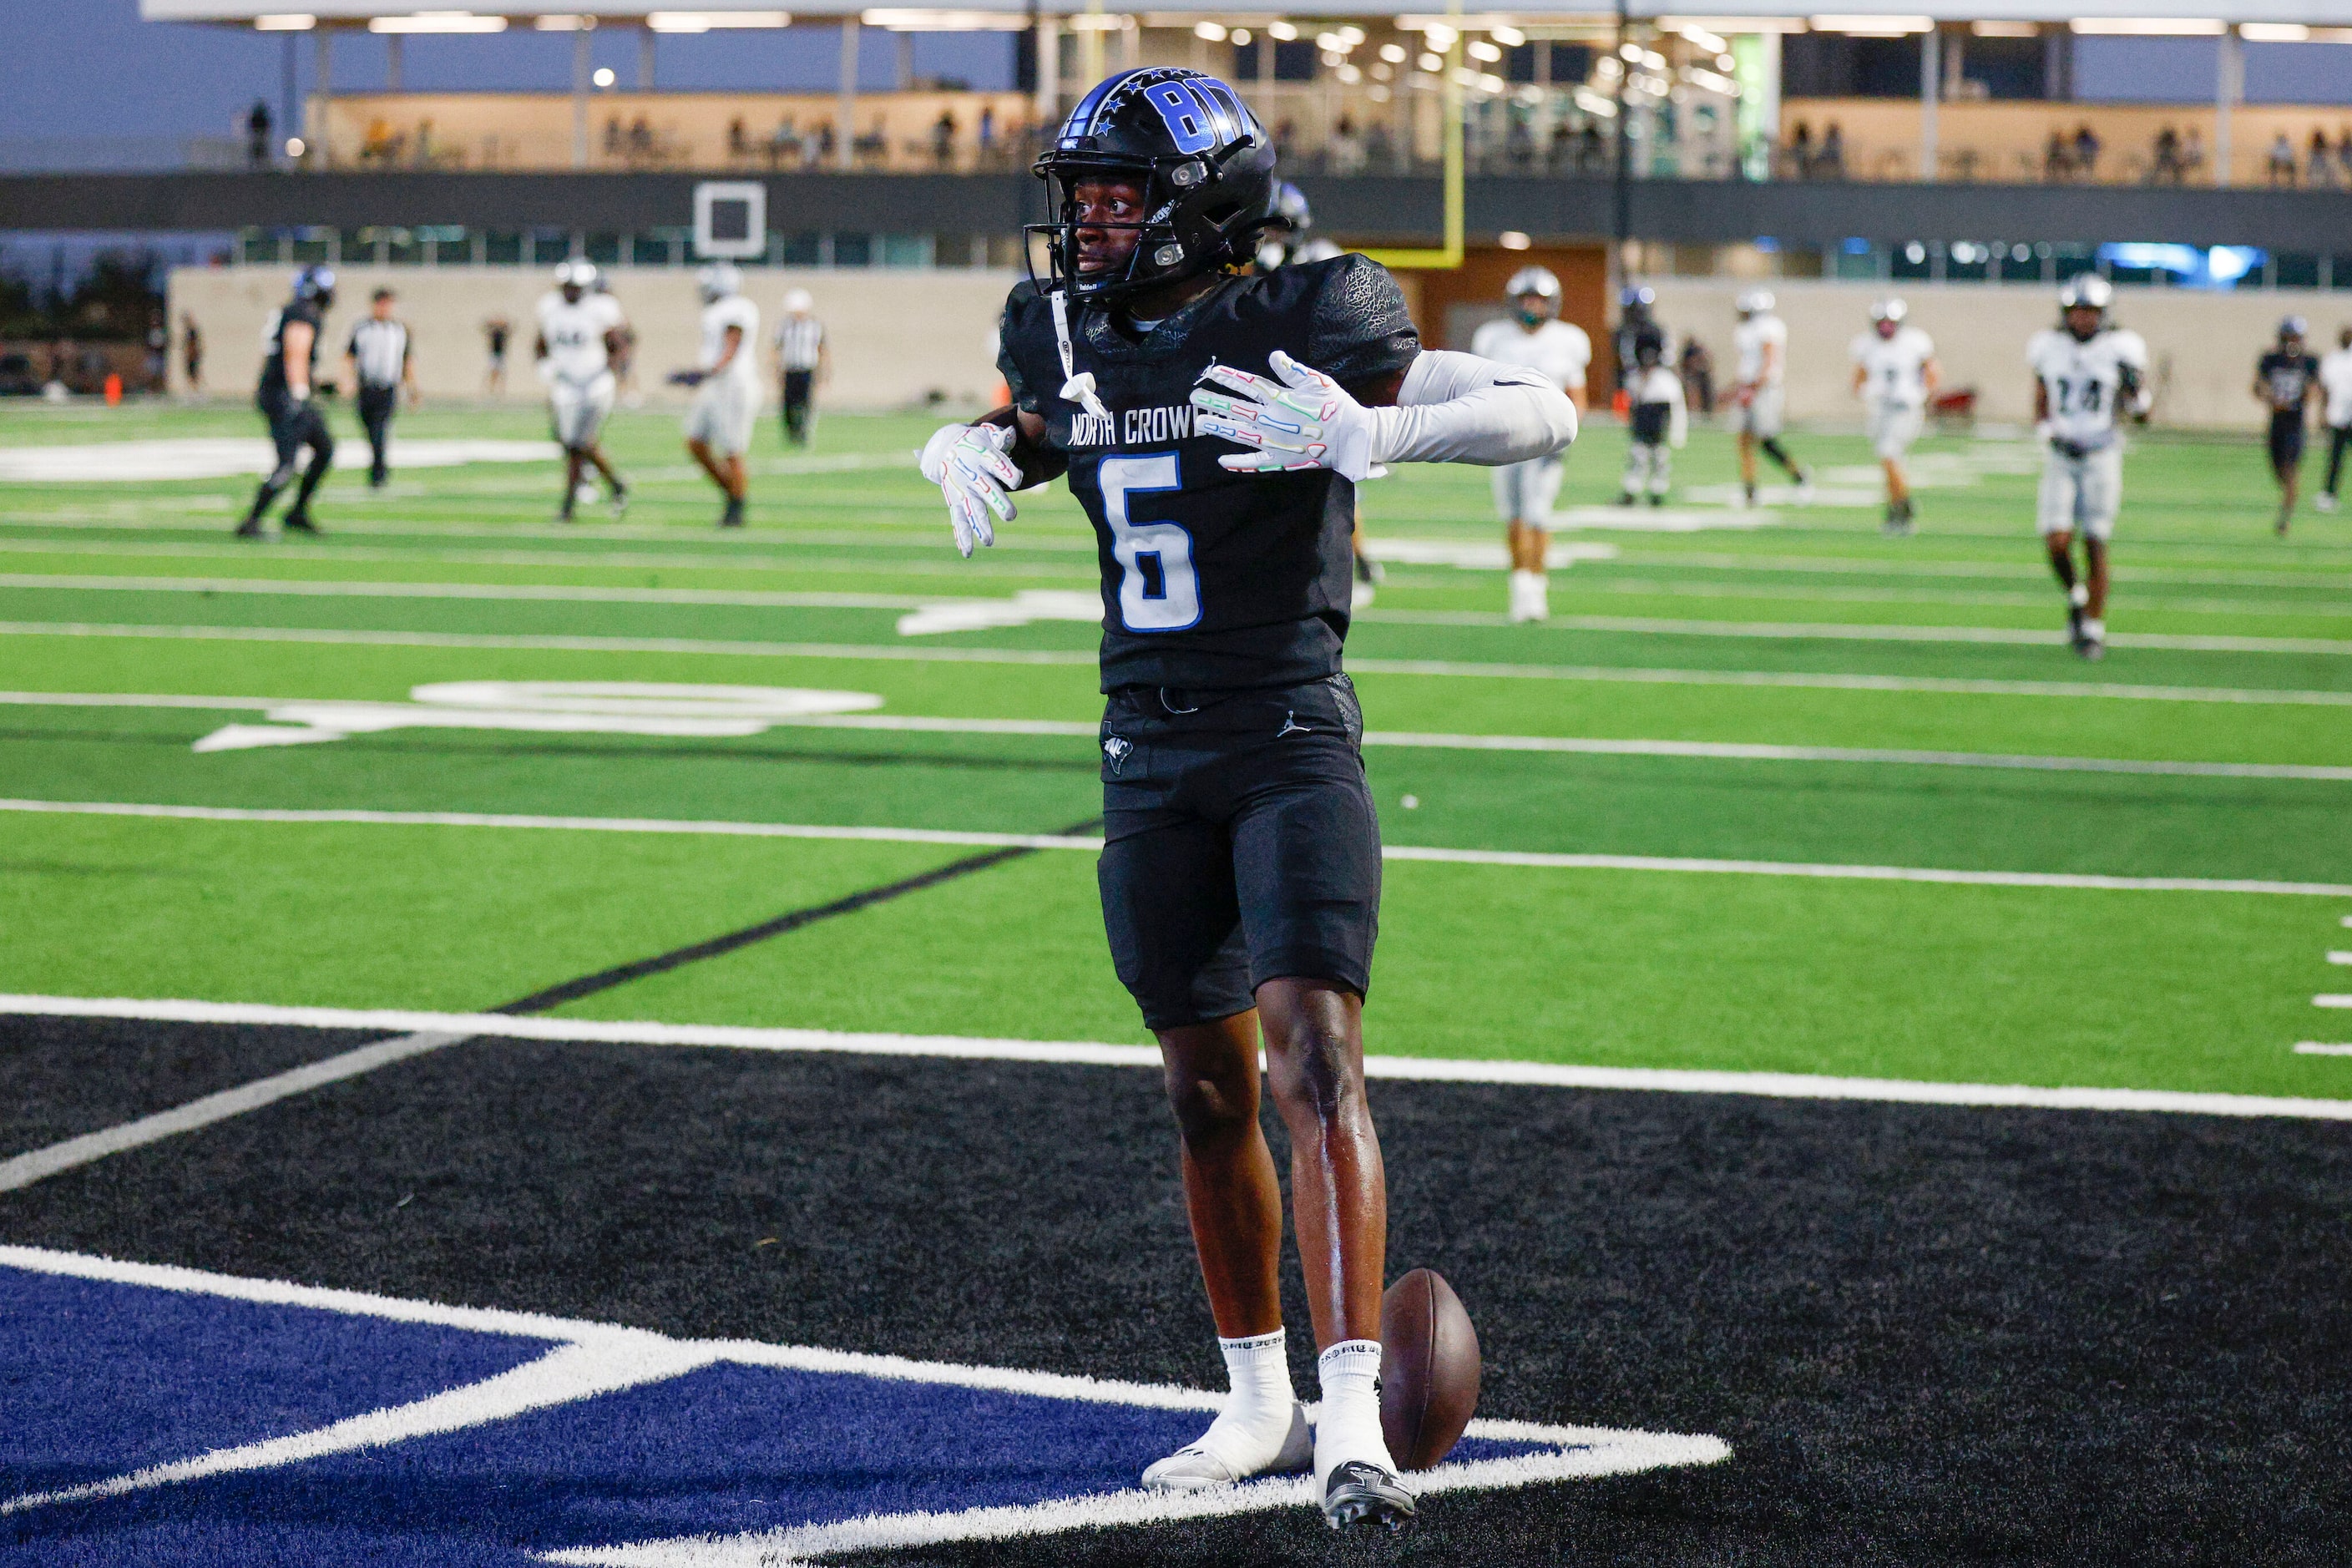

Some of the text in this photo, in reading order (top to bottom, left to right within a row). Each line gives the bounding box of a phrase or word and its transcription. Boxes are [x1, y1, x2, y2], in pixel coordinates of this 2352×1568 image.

[1144, 77, 1256, 155] 817
[1067, 411, 1116, 447] NORTH
[1099, 451, 1204, 632] 6
